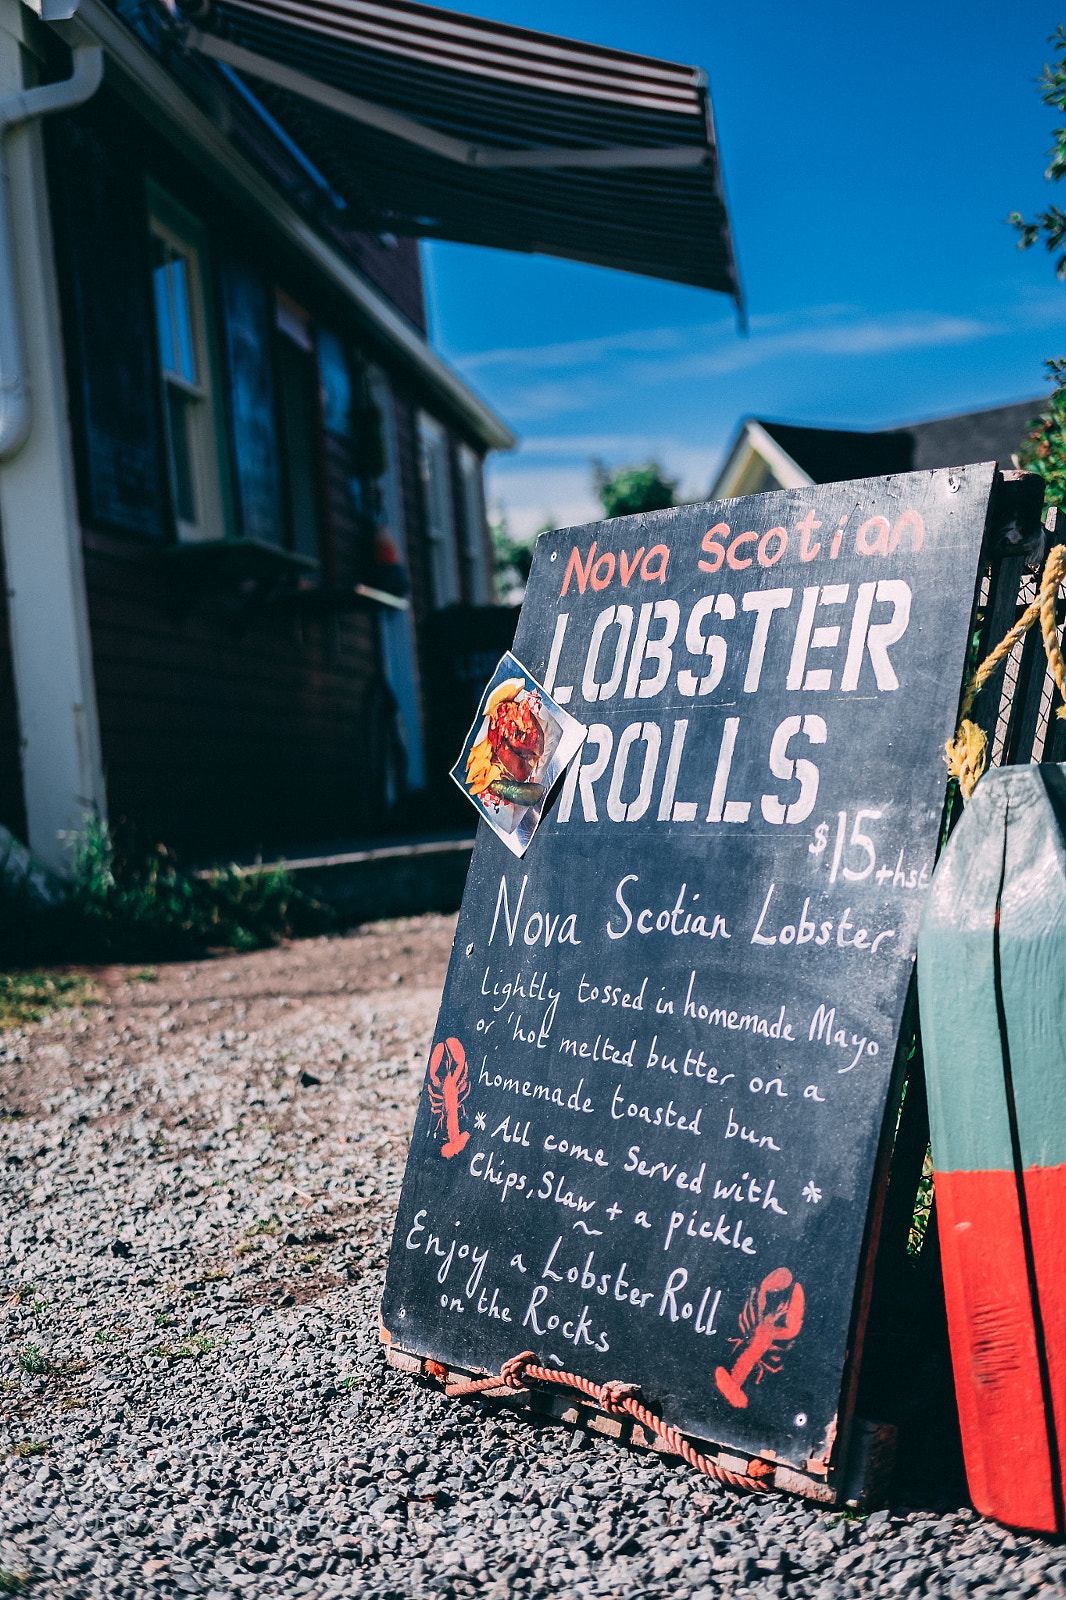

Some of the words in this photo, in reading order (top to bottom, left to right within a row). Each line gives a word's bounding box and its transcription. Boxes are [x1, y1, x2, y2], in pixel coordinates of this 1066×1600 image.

[560, 541, 670, 597] Nova
[698, 509, 925, 574] Scotian
[543, 578, 913, 705] LOBSTER
[556, 714, 828, 825] ROLLS
[488, 874, 582, 947] Nova
[606, 874, 731, 940] Scotian
[751, 883, 895, 954] Lobster
[476, 1018, 495, 1034] or
[558, 1034, 637, 1068] melted
[646, 1035, 735, 1086] butter
[749, 1076, 788, 1097] on
[803, 1084, 826, 1102] a
[578, 973, 649, 1010] tossed
[656, 986, 674, 1014] in
[684, 970, 796, 1042] homemade
[808, 1003, 879, 1074] Mayo
[478, 1055, 594, 1113] homemade
[611, 1083, 702, 1137] toasted
[725, 1107, 782, 1151] bun
[543, 1132, 609, 1167] come
[713, 1171, 788, 1216] with
[405, 1209, 490, 1298] Enjoy
[510, 1253, 527, 1274] a
[542, 1236, 655, 1308] Lobster
[659, 1266, 720, 1337] Roll
[634, 1210, 652, 1229] a
[665, 1210, 758, 1255] pickle
[439, 1292, 465, 1314] on
[477, 1288, 513, 1323] the
[523, 1285, 612, 1353] Rocks
